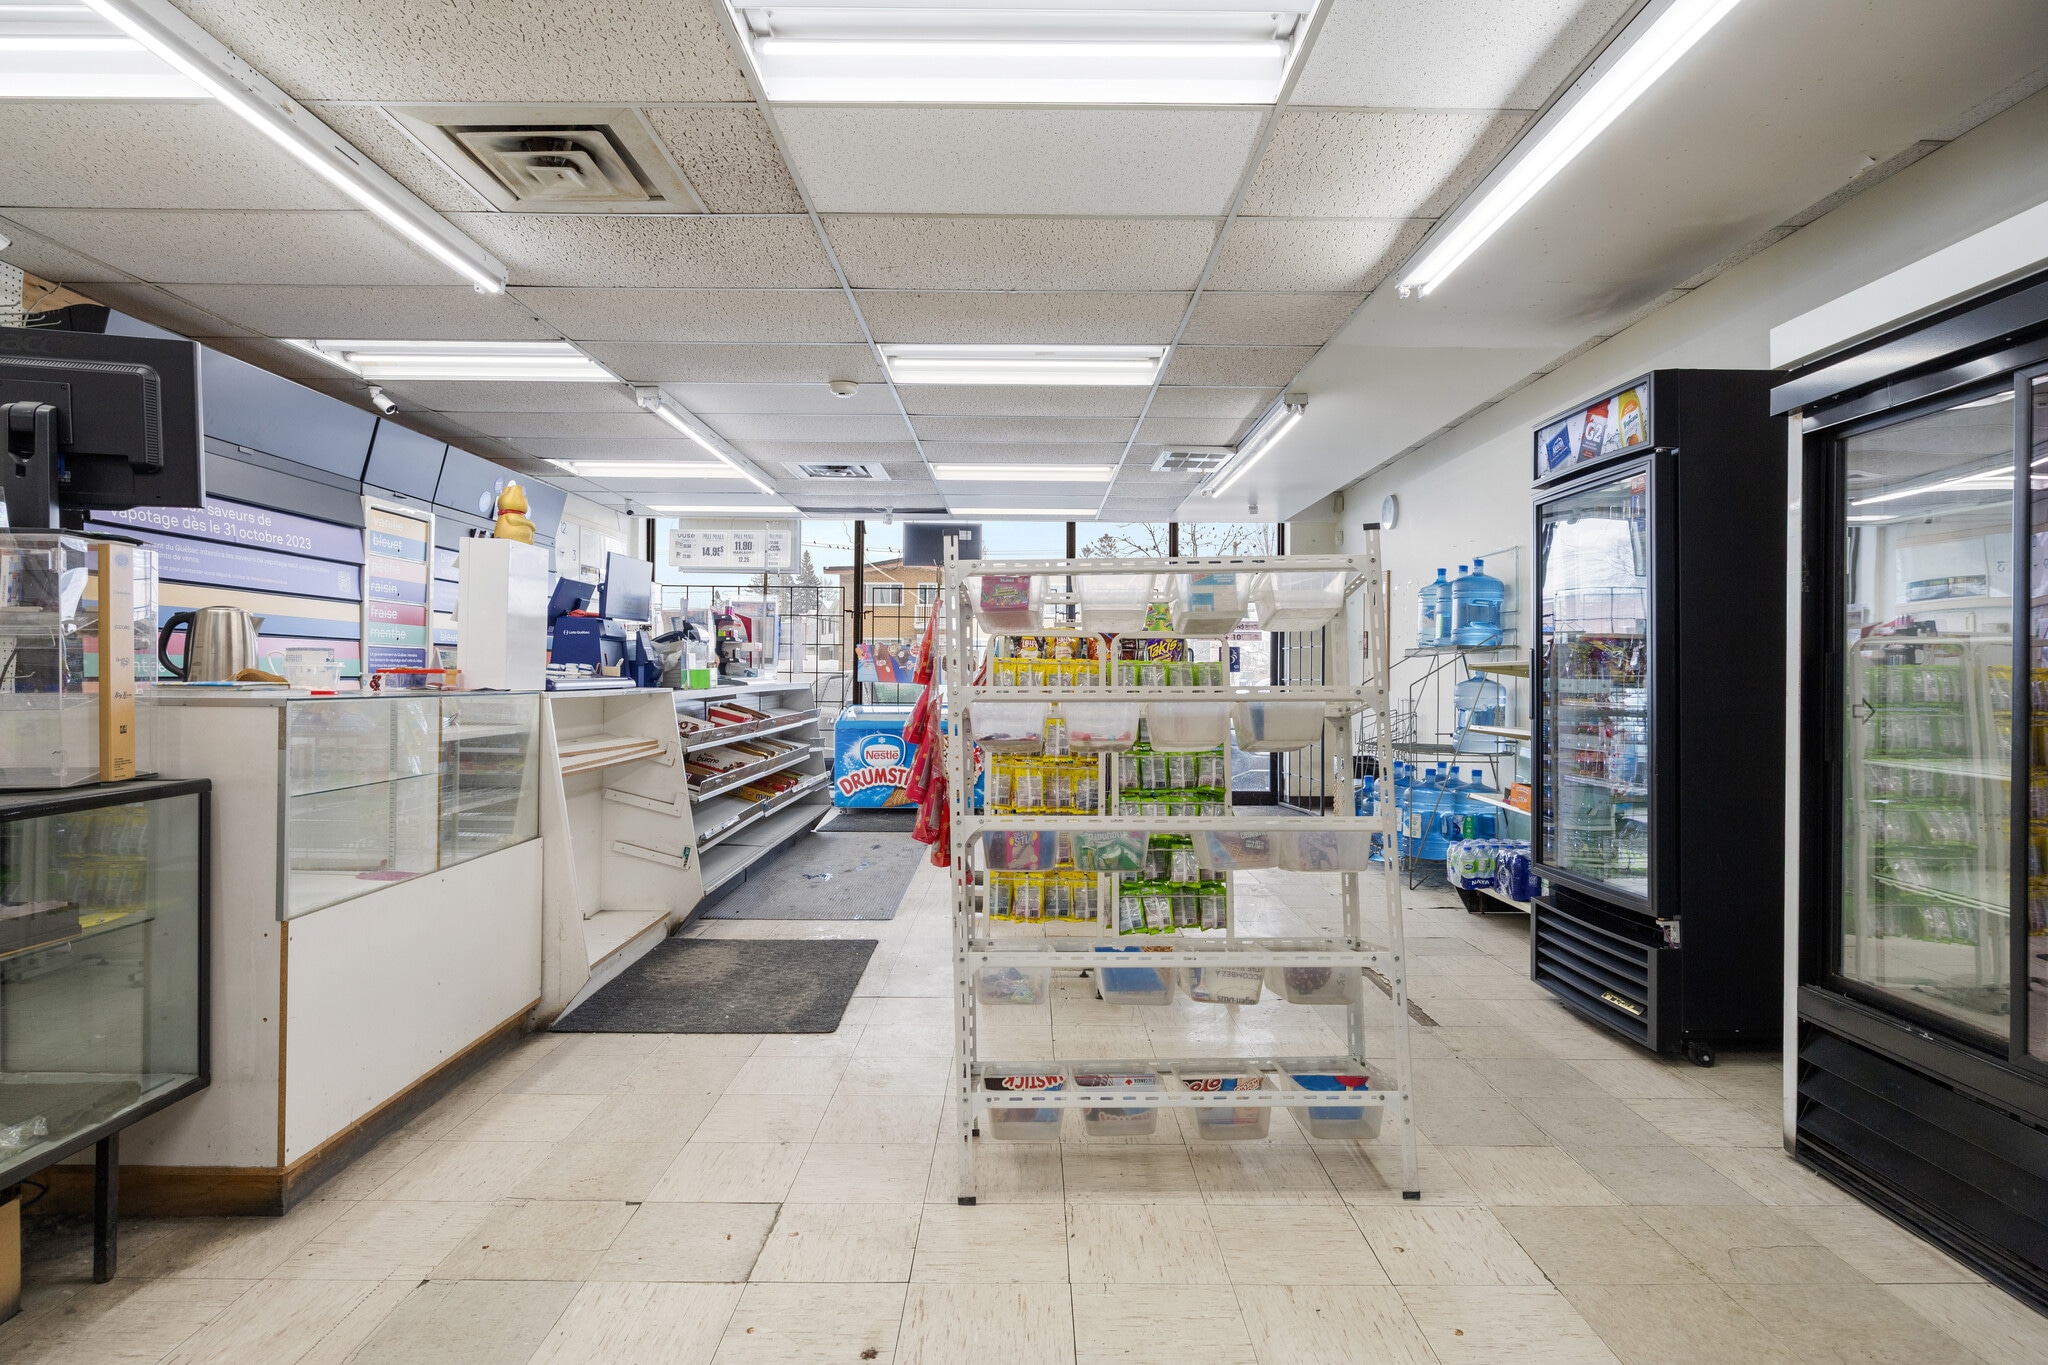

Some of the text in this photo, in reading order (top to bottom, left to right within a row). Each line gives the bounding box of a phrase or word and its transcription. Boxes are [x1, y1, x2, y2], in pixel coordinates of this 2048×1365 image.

[1586, 422, 1602, 442] G2
[208, 505, 255, 524] saveurs
[258, 512, 272, 527] de
[373, 516, 403, 531] vanille
[183, 516, 207, 532] dès
[209, 520, 221, 534] le
[224, 523, 237, 536] 31
[239, 528, 283, 544] octobre
[285, 534, 312, 550] 2023
[373, 534, 402, 550] bleuet
[175, 545, 199, 554] Québec
[572, 550, 576, 561] 3
[371, 581, 397, 594] raisin
[371, 606, 398, 619] fraise
[370, 627, 406, 640] menthe
[1147, 640, 1177, 658] Takis
[697, 756, 719, 764] bueno
[865, 750, 899, 760] Nestlé
[1222, 971, 1262, 980] CCOMBEZ
